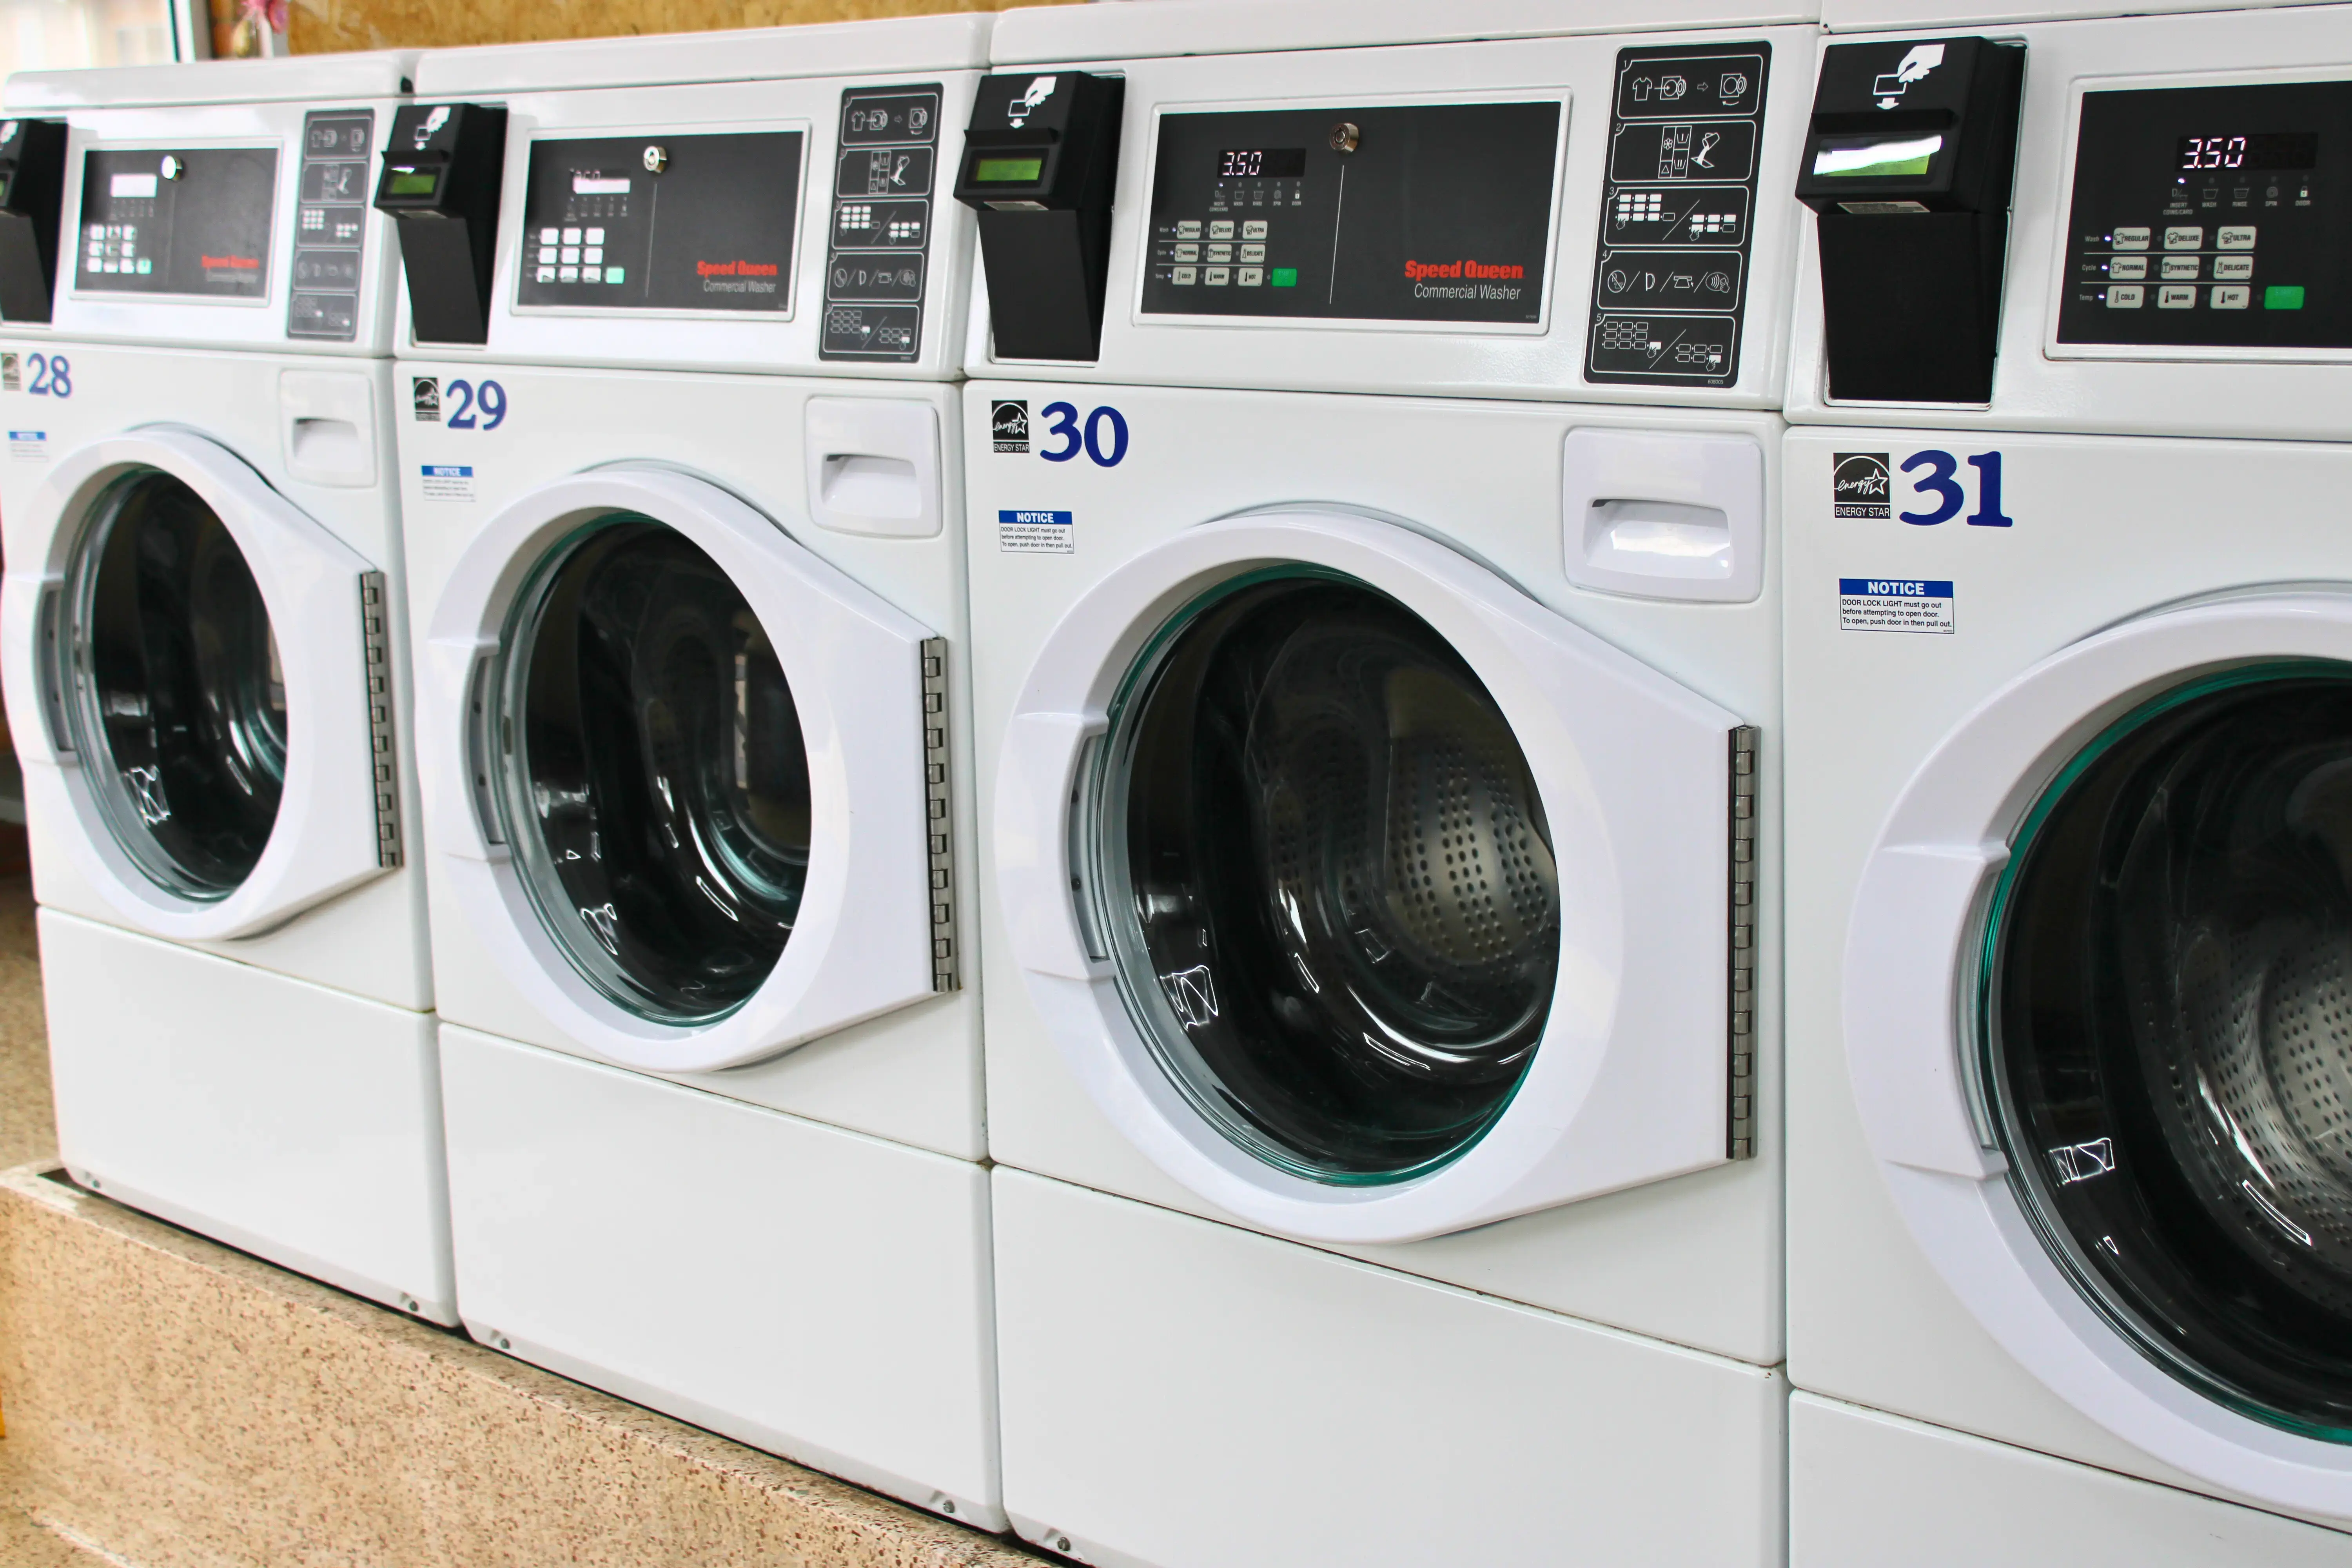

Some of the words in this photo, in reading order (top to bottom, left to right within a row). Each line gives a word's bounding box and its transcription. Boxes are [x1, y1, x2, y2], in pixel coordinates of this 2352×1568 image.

[2182, 137, 2245, 168] 3.50
[1222, 151, 1262, 176] 3.50
[697, 260, 736, 278] Speed
[1405, 260, 1461, 281] Speed
[1465, 260, 1523, 279] Queen
[704, 279, 746, 293] Commercial
[748, 280, 776, 293] Washer
[1414, 283, 1477, 299] Commercial
[1480, 285, 1521, 299] Washer
[27, 352, 72, 399] 28
[446, 379, 507, 431] 29
[1040, 401, 1129, 468] 30
[434, 467, 461, 477] NOTICE
[1838, 479, 1870, 495] energy
[1899, 450, 2013, 528] 31
[1016, 512, 1054, 523] NOTICE
[1836, 507, 1867, 516] ENERGY
[1869, 507, 1889, 517] STAR
[1868, 582, 1925, 595] NOTICE
